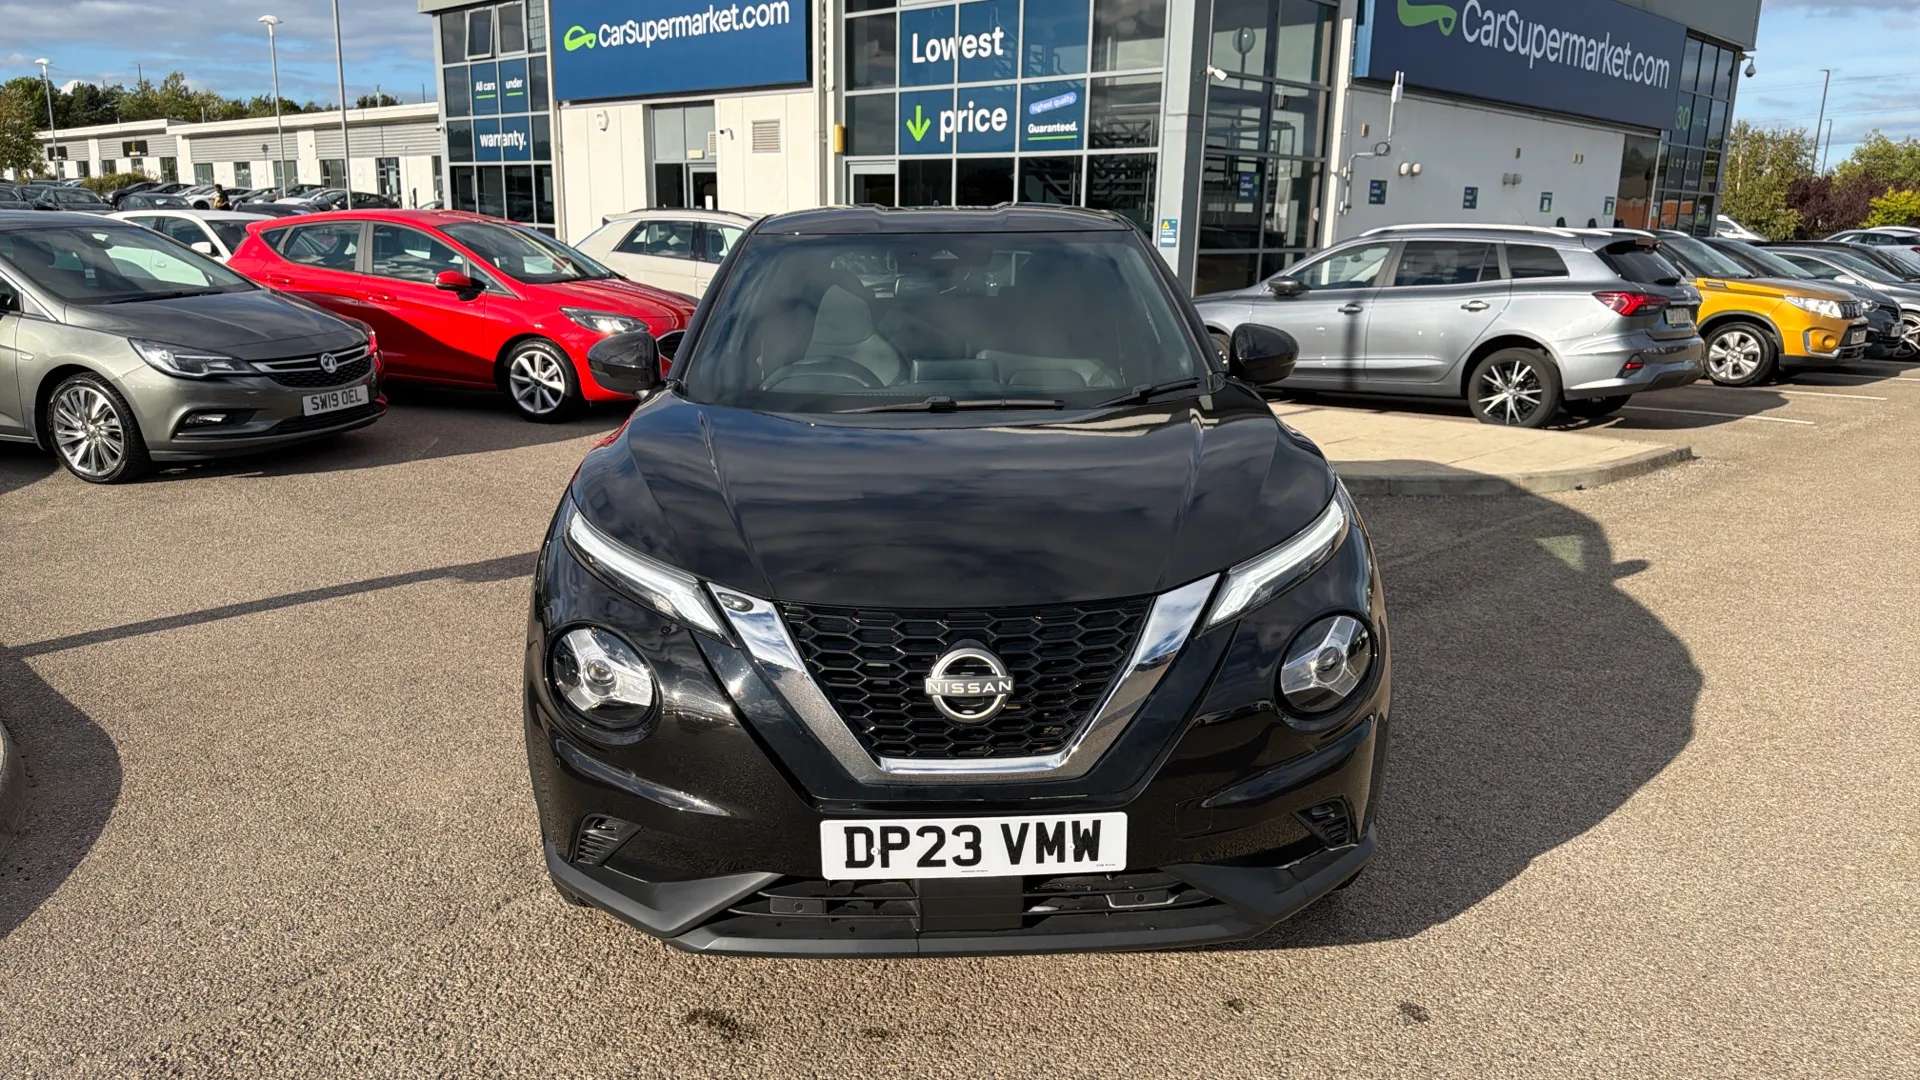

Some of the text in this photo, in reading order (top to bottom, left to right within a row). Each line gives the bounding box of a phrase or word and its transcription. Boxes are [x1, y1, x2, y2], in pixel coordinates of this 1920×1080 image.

[599, 1, 789, 48] CarSupermarket.com
[911, 26, 1004, 64] Lowest
[1462, 0, 1669, 89] CarSupermarket.com
[475, 78, 523, 91] All cars under
[940, 100, 1008, 142] price
[1028, 122, 1078, 133] Guaranteed.
[480, 130, 527, 151] warranty.
[311, 389, 363, 411] SW19 OEL
[928, 680, 1012, 694] NISSAN
[843, 819, 1102, 869] DP23 VMW
